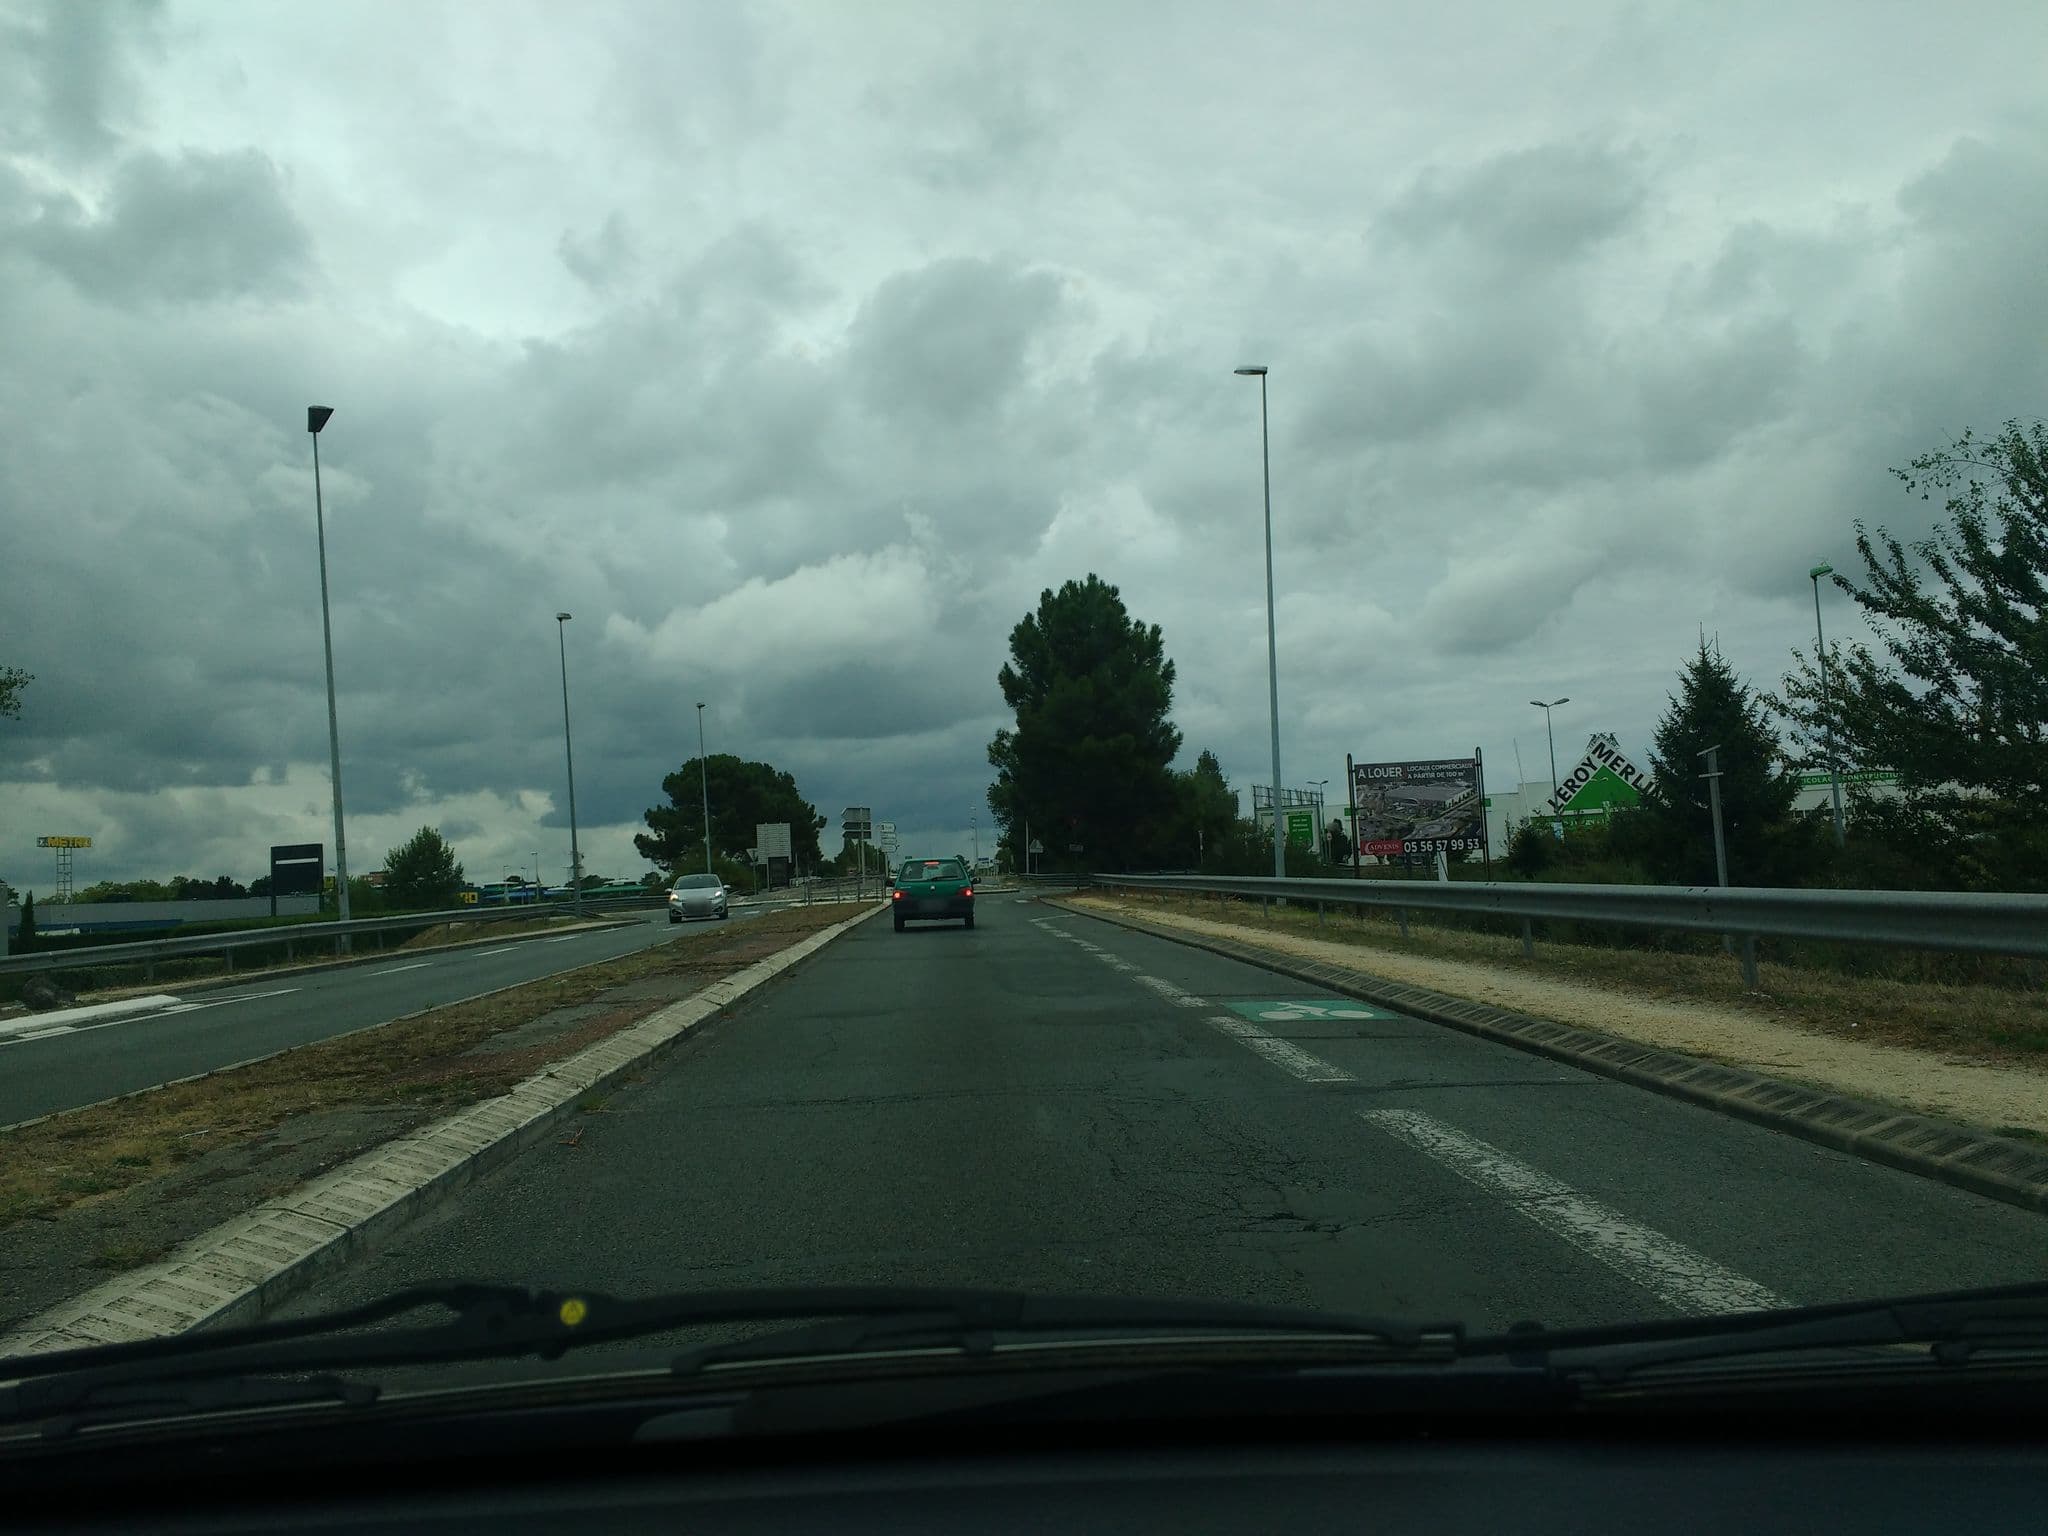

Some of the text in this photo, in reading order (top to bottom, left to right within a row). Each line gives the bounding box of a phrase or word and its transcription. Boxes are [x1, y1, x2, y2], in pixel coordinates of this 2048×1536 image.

[1358, 767, 1402, 779] A LOUER
[1547, 756, 1598, 813] LEROY
[1592, 742, 1660, 796] MERLI
[1404, 838, 1479, 853] 05 56 57 99 53
